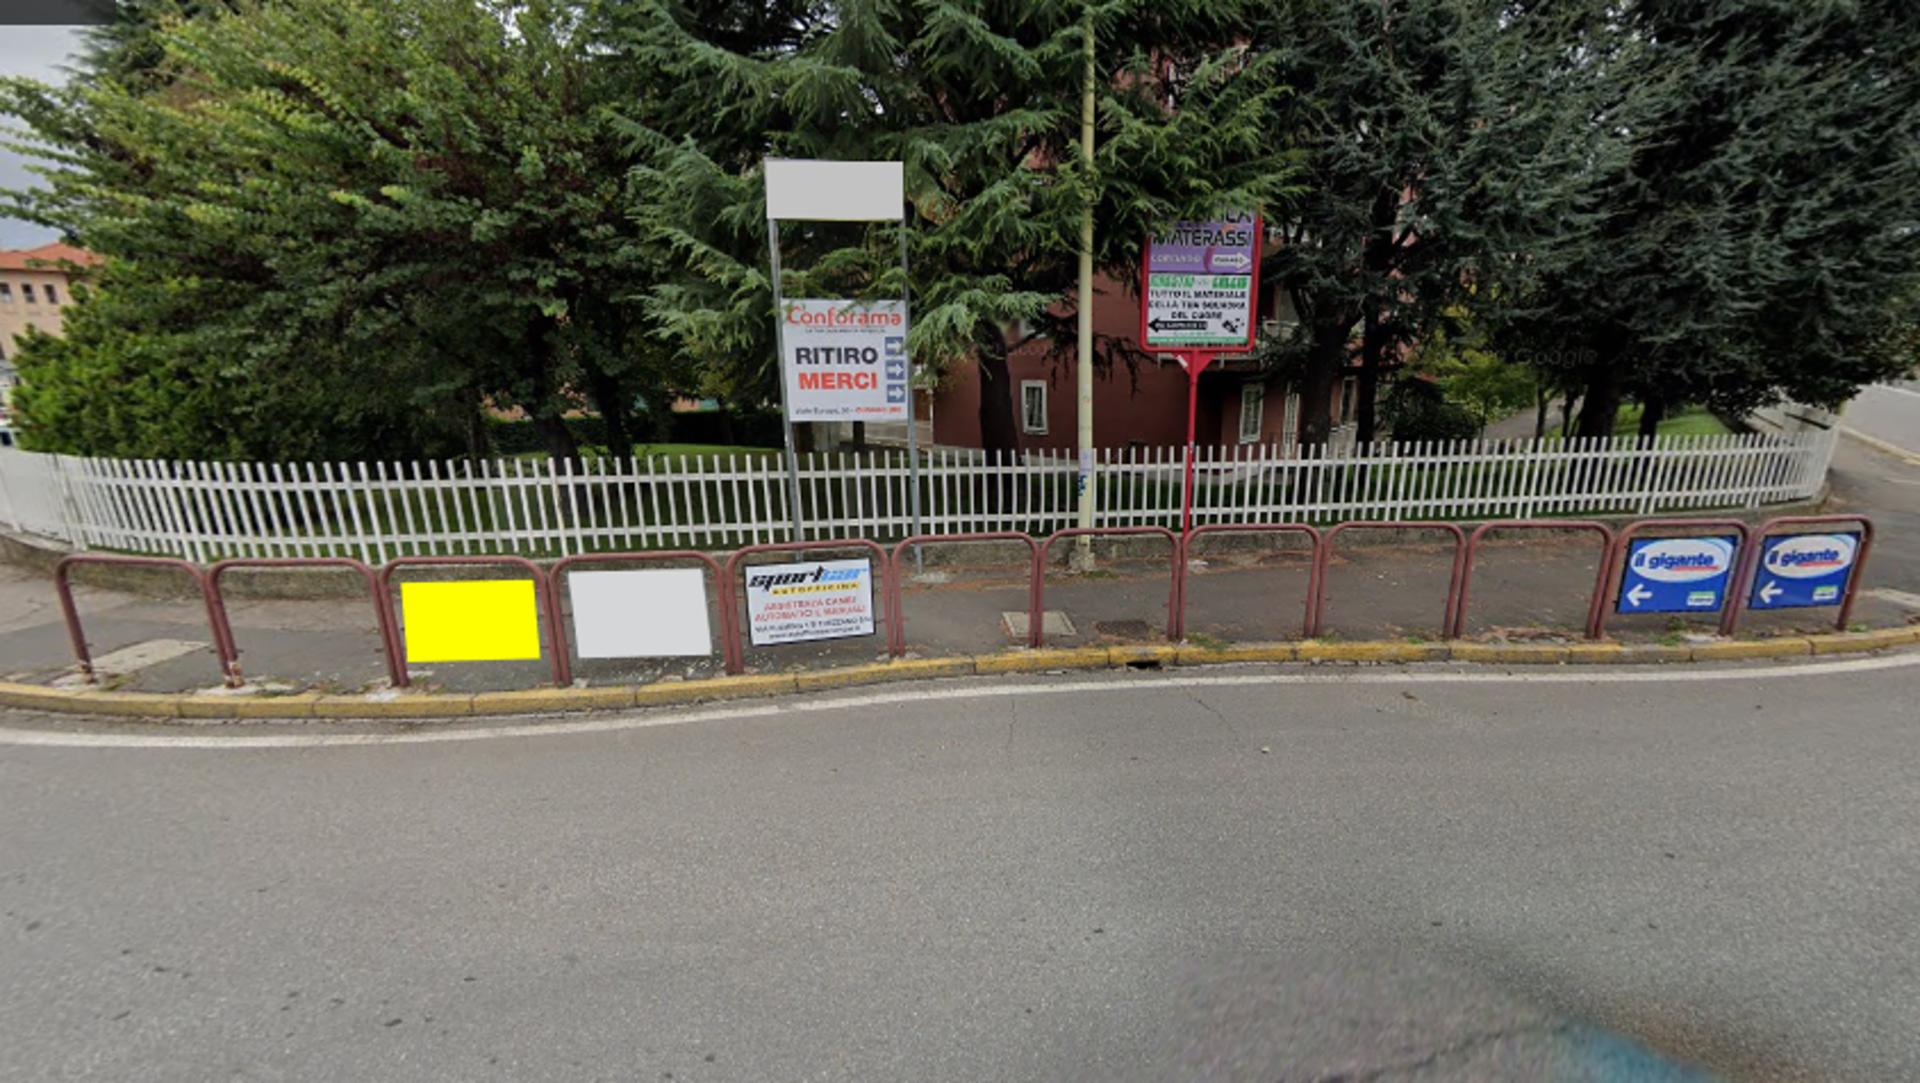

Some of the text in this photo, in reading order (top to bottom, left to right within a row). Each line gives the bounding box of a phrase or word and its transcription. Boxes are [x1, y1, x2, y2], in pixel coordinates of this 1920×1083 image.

[1194, 290, 1246, 298] MATERIALE
[787, 305, 902, 328] Conforama
[795, 346, 879, 365] RITIRO
[798, 372, 878, 390] MERCI
[1635, 552, 1715, 570] il gigante
[1768, 549, 1839, 568] il gigante
[771, 582, 860, 596] AUTOFFICINA
